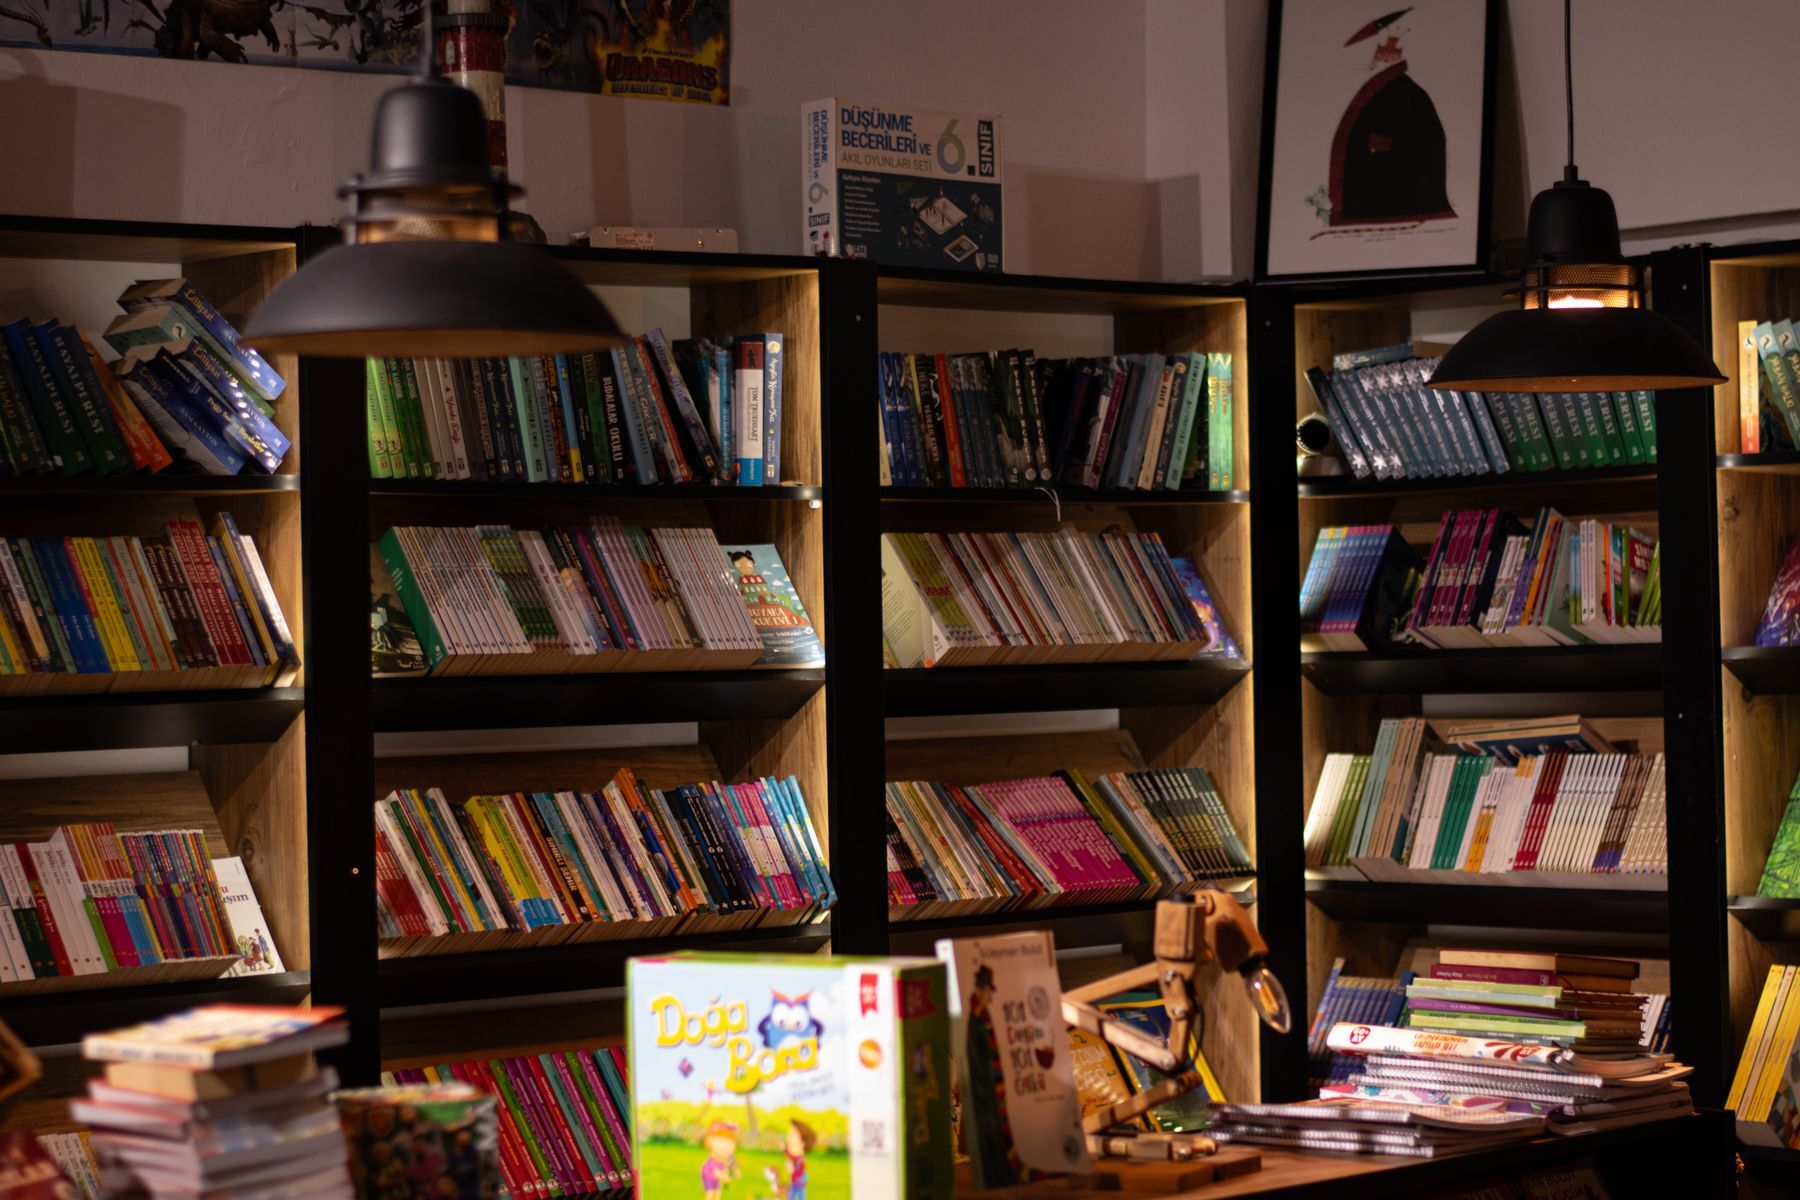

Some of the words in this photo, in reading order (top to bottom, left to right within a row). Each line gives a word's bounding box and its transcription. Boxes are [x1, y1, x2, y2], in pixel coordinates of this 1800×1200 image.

[606, 53, 718, 90] DRAGONS
[820, 109, 828, 162] DÜŞÜNME
[841, 106, 912, 132] DÜŞÜNME
[841, 153, 861, 164] AKIL
[865, 156, 911, 169] OYUNLARI
[913, 160, 931, 171] SETİ
[842, 130, 916, 153] BECERİLERİ
[918, 143, 931, 155] VE
[979, 121, 993, 175] SINIF
[810, 214, 829, 227] SINIF
[181, 285, 217, 323] Lilliput
[25, 334, 74, 434] HAYALPEREST
[53, 334, 104, 434] HAYALPEREST
[600, 375, 619, 425] BUDALALAR
[637, 396, 658, 441] GÖKLER
[1543, 394, 1564, 439] PEREST
[1561, 392, 1581, 437] PEREST
[1578, 391, 1598, 437] PEREST
[1596, 391, 1615, 436] PEREST
[1616, 390, 1634, 434] PEREST
[1635, 389, 1654, 433] PEREST
[608, 426, 623, 462] OKULU
[545, 834, 565, 866] SİHİRLİ
[559, 865, 577, 892] ŞEHİR
[651, 993, 748, 1047] Doğa
[1003, 1000, 1026, 1025] 101
[1011, 1048, 1034, 1072] 101
